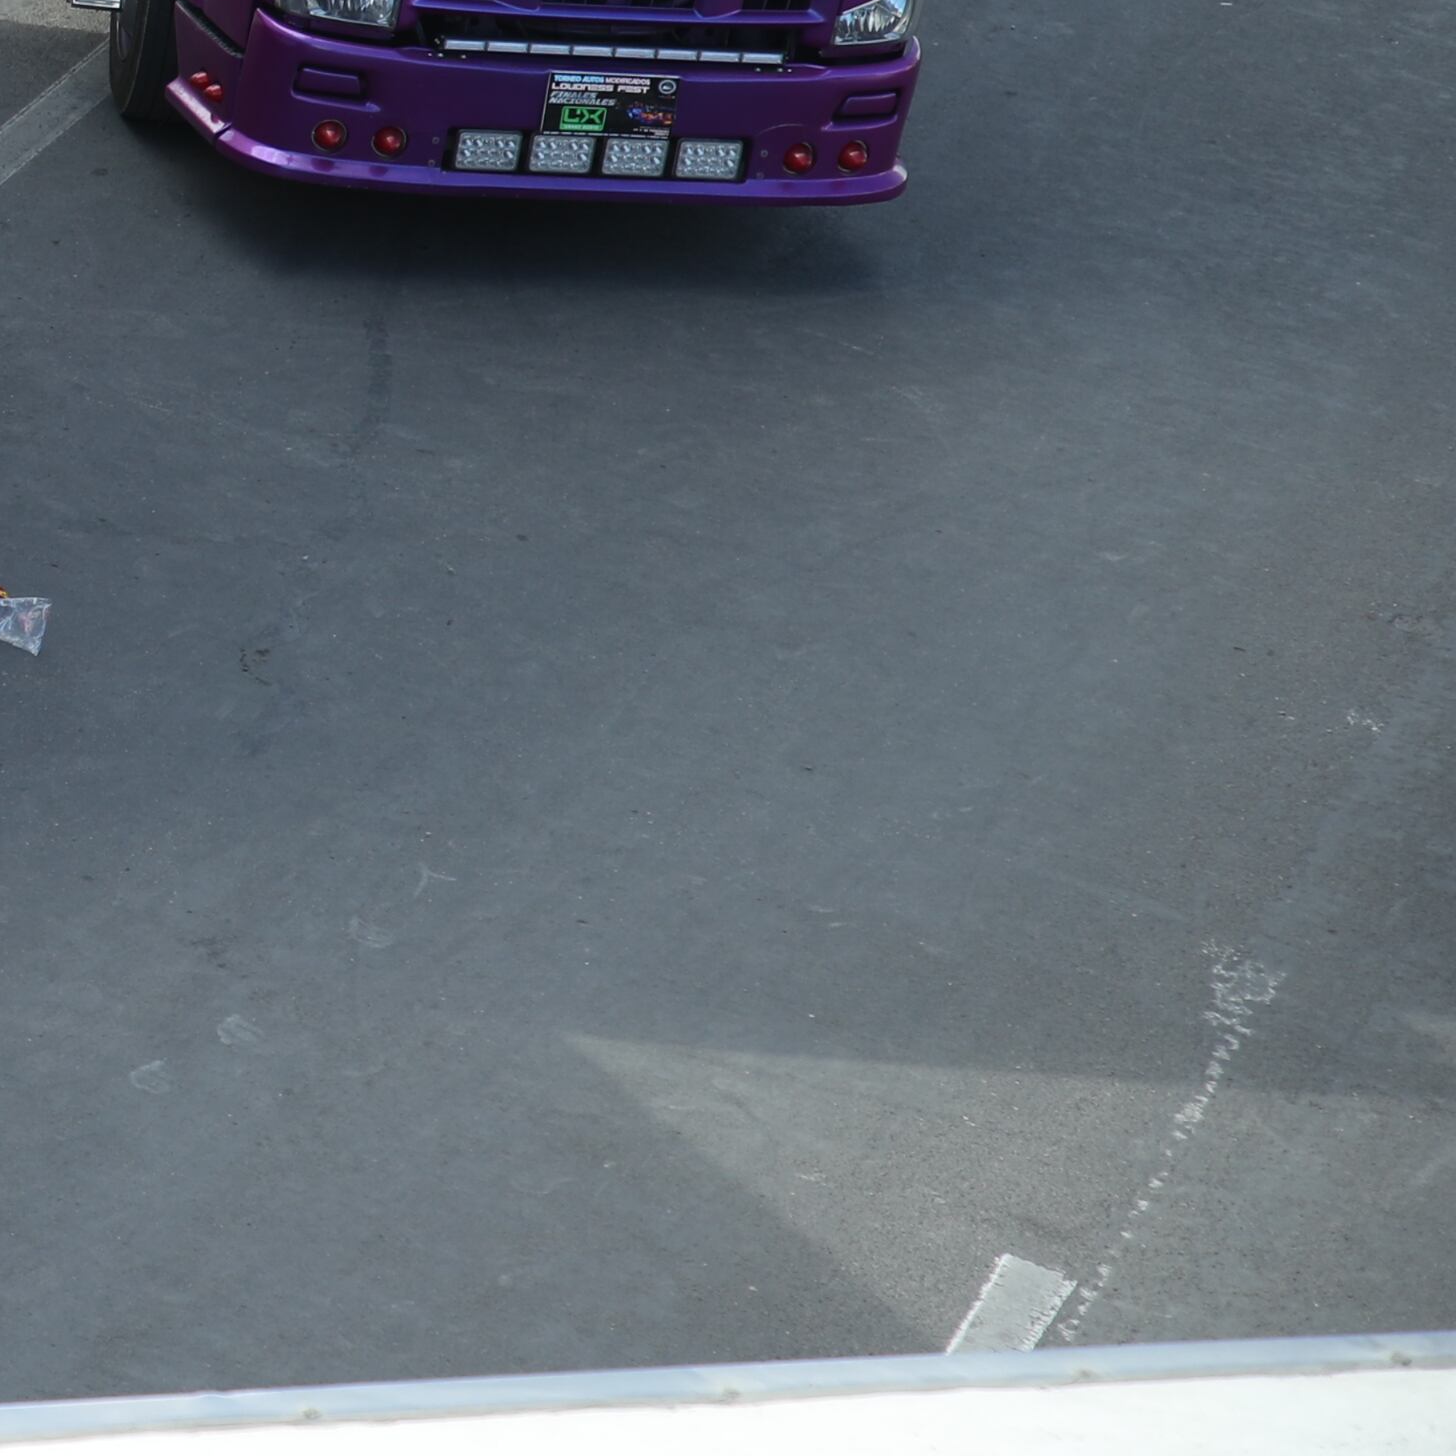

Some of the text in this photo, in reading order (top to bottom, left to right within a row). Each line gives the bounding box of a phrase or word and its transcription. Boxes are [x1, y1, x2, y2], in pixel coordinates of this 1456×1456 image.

[552, 83, 649, 94] LOUDNESS FEST
[548, 98, 617, 106] NACIONALES
